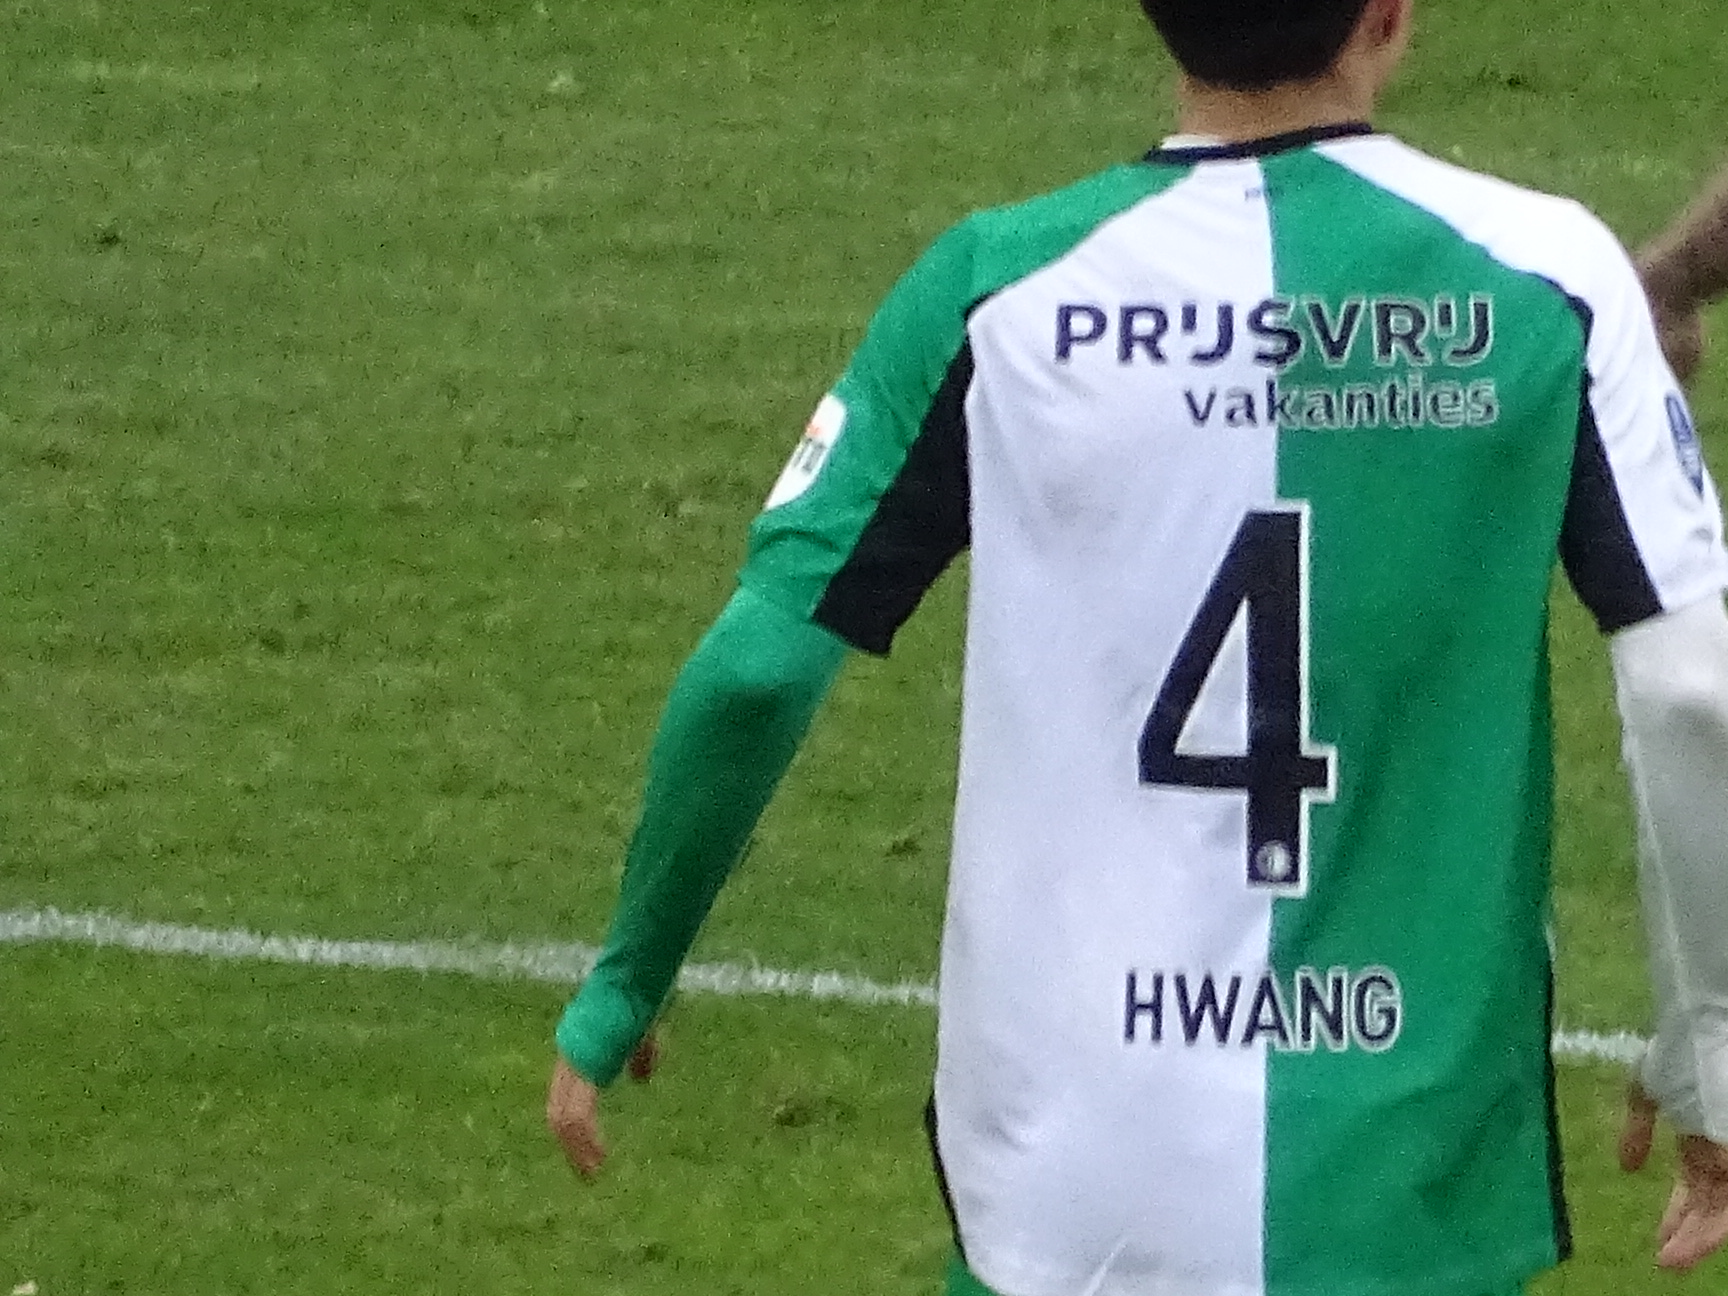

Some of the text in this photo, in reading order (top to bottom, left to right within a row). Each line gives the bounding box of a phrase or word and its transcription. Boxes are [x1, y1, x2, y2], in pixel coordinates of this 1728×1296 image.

[1185, 375, 1499, 429] vakanties
[1137, 503, 1337, 895] 4
[1123, 968, 1402, 1051] HWANG
